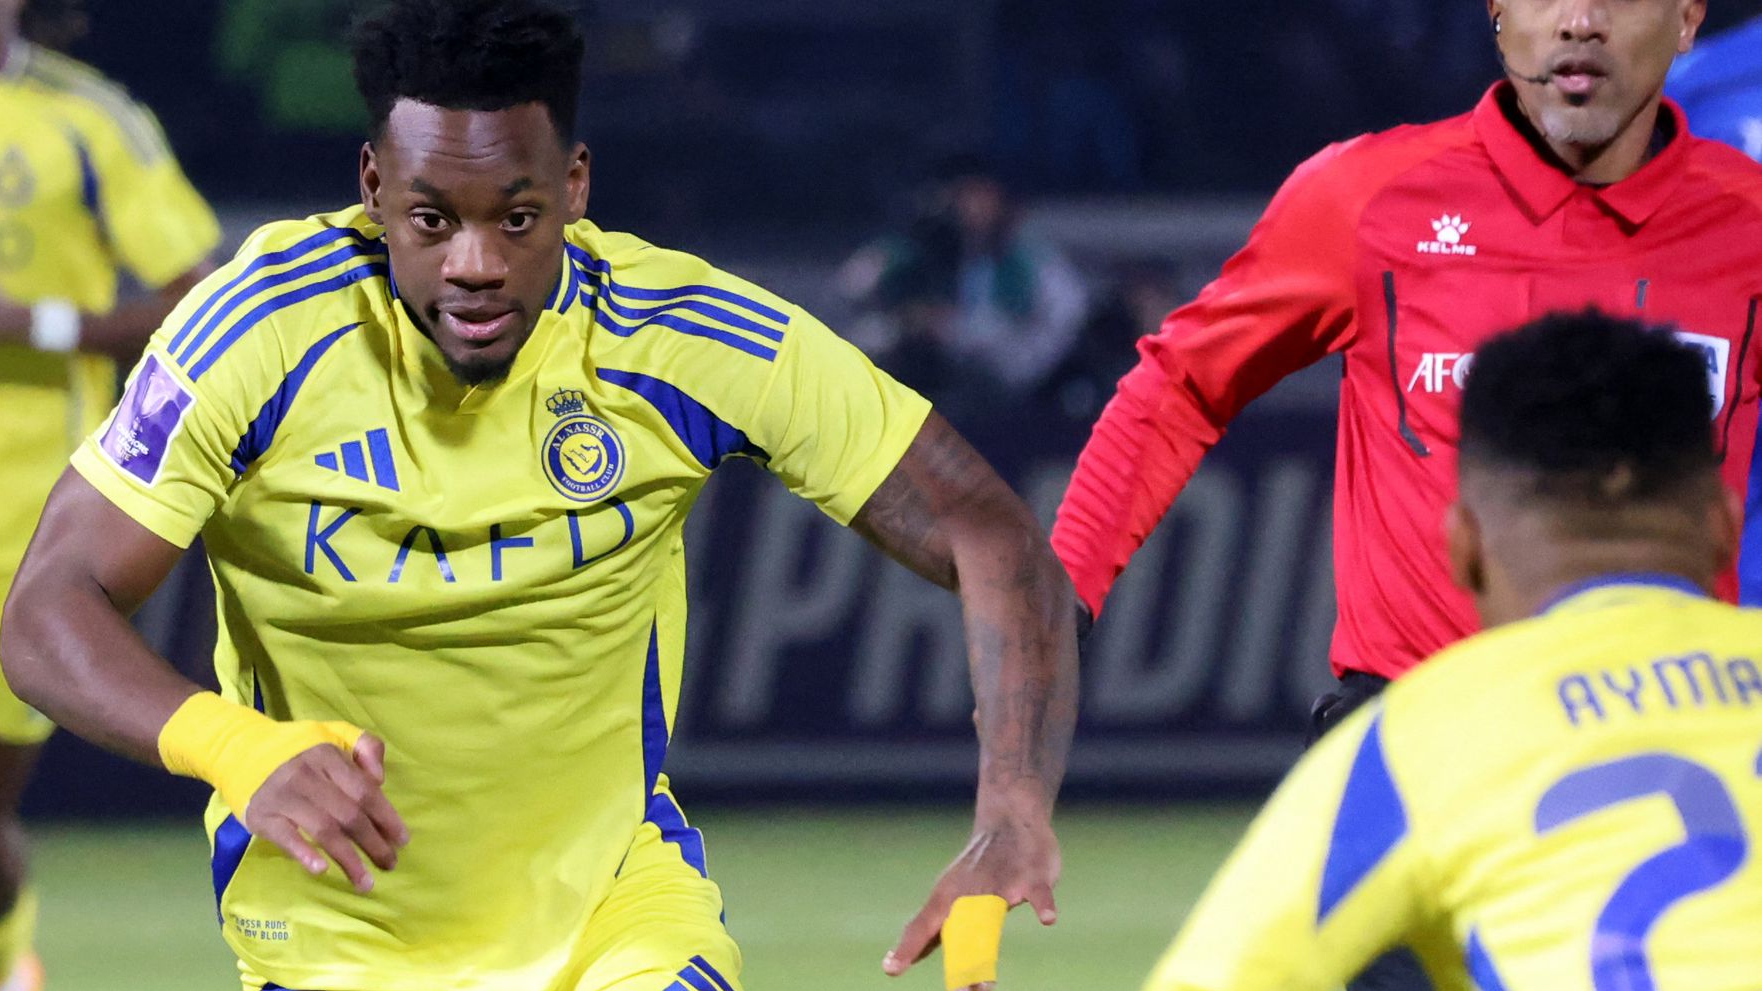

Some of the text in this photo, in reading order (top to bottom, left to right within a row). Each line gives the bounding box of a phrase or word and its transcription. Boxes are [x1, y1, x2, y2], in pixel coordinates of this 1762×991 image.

[1416, 241, 1477, 256] KELME
[552, 423, 605, 451] AL NASSR
[561, 463, 614, 493] FOOTBALL CLUB
[304, 499, 636, 583] KAFD
[260, 930, 289, 941] BLOOD
[265, 920, 287, 930] RUNS
